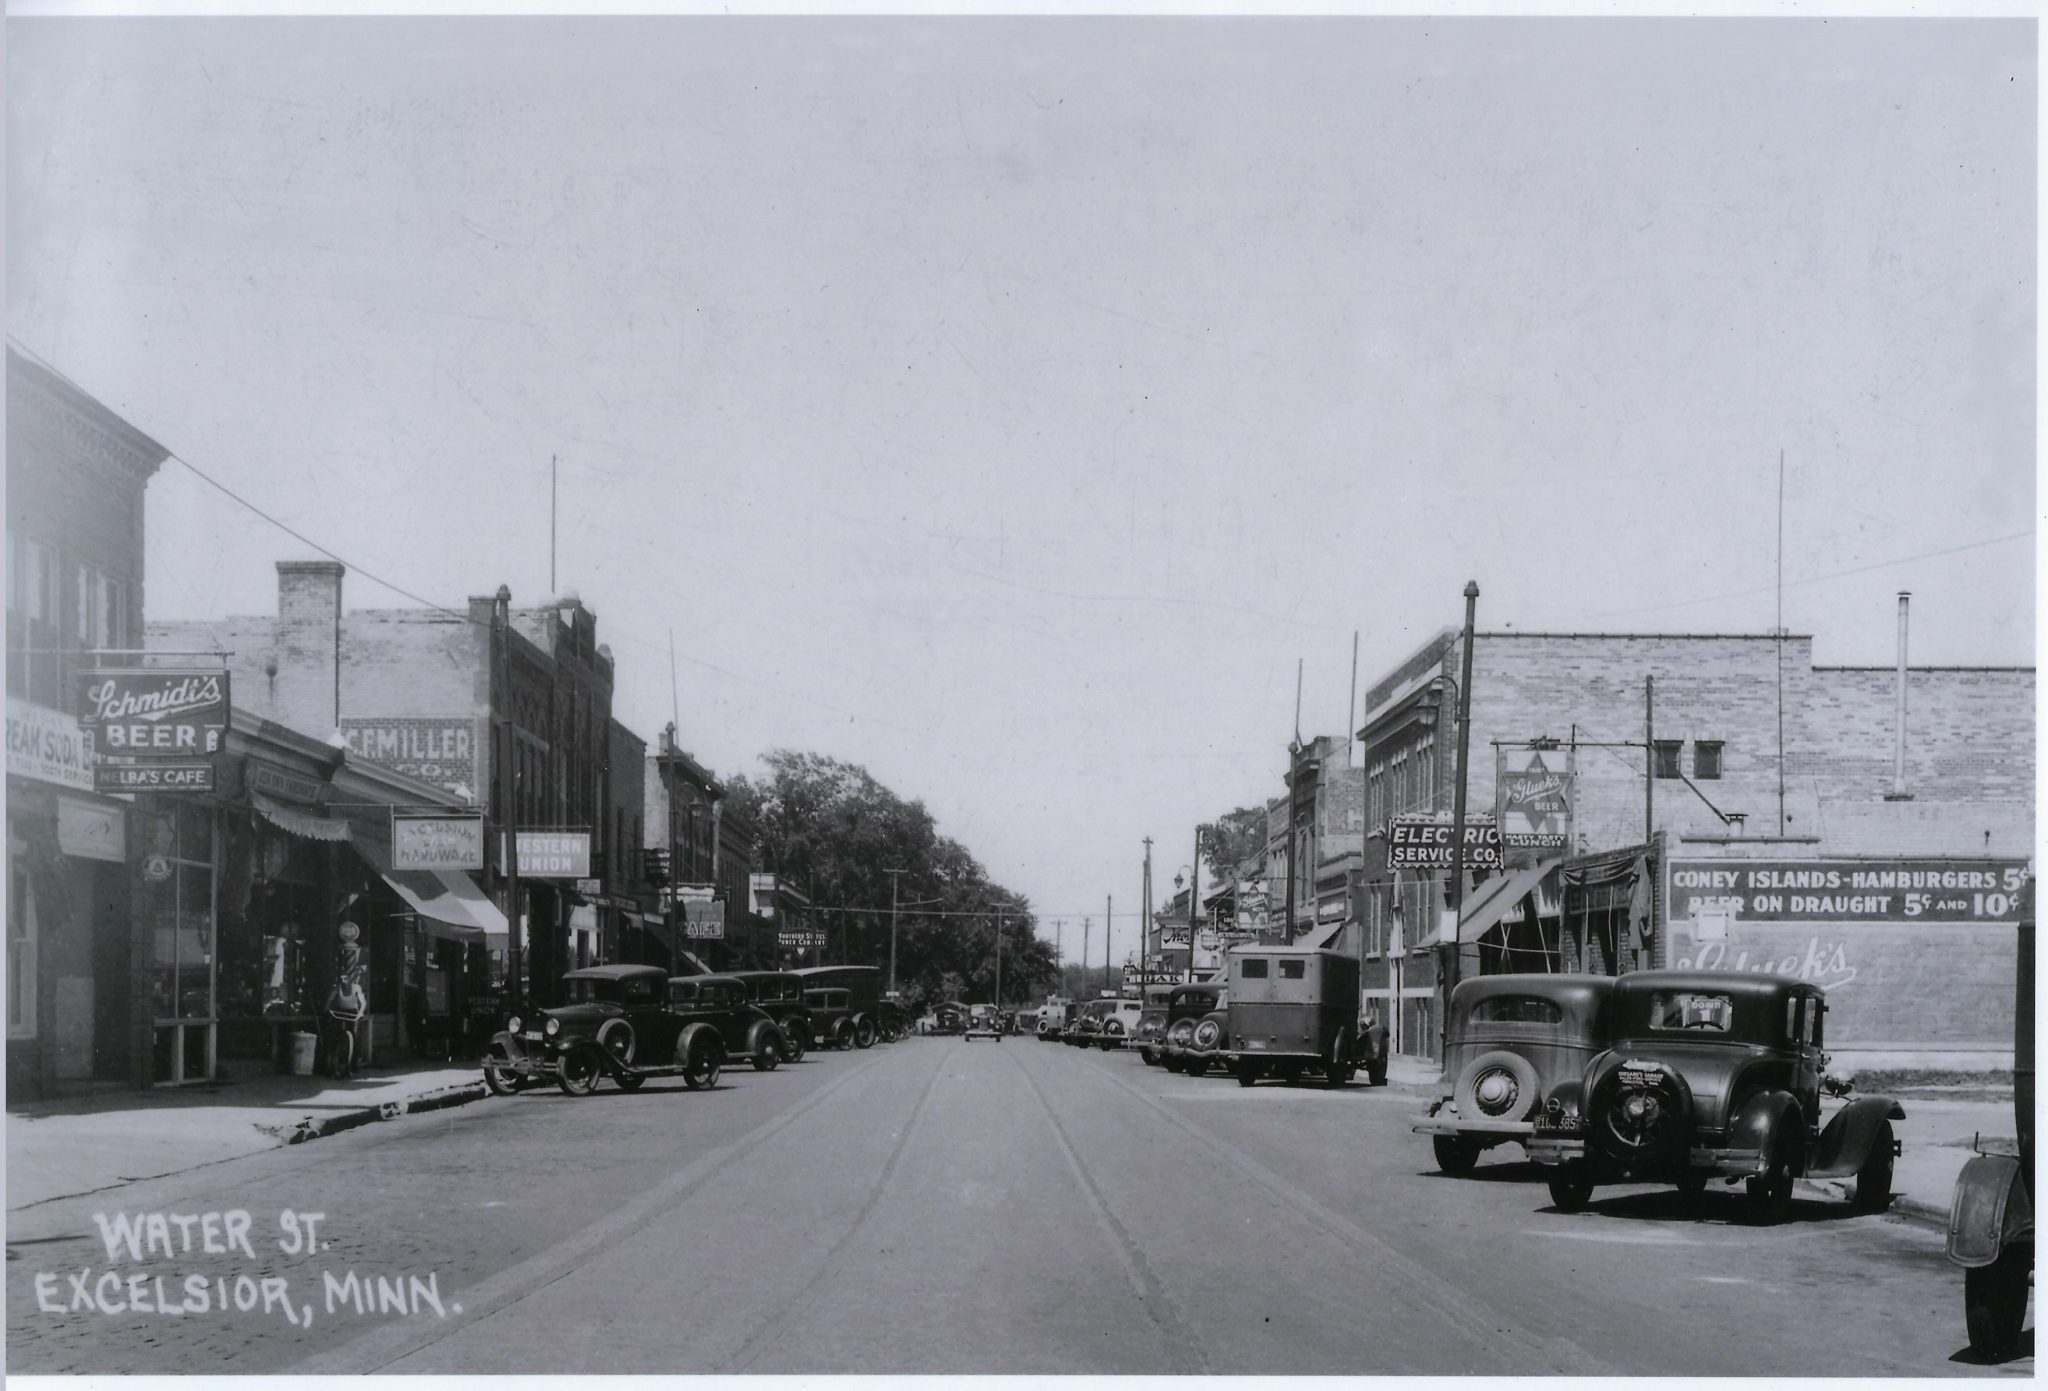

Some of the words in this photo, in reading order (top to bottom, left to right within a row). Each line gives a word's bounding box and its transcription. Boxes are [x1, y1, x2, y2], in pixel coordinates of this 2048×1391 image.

[84, 675, 221, 720] Schmidt's
[106, 725, 197, 747] BEER
[163, 770, 206, 784] CAFE
[1535, 801, 1559, 811] BEER
[1393, 827, 1498, 844] ELECRIC
[1509, 839, 1561, 847] LUNCH
[1394, 847, 1466, 862] SERVIC
[1473, 848, 1499, 863] CO.
[520, 856, 572, 872] UNION
[1674, 871, 1739, 888] CONEY
[1753, 895, 1783, 913] ON
[1790, 895, 1892, 914] DRAUGHT
[1936, 900, 1967, 910] AND
